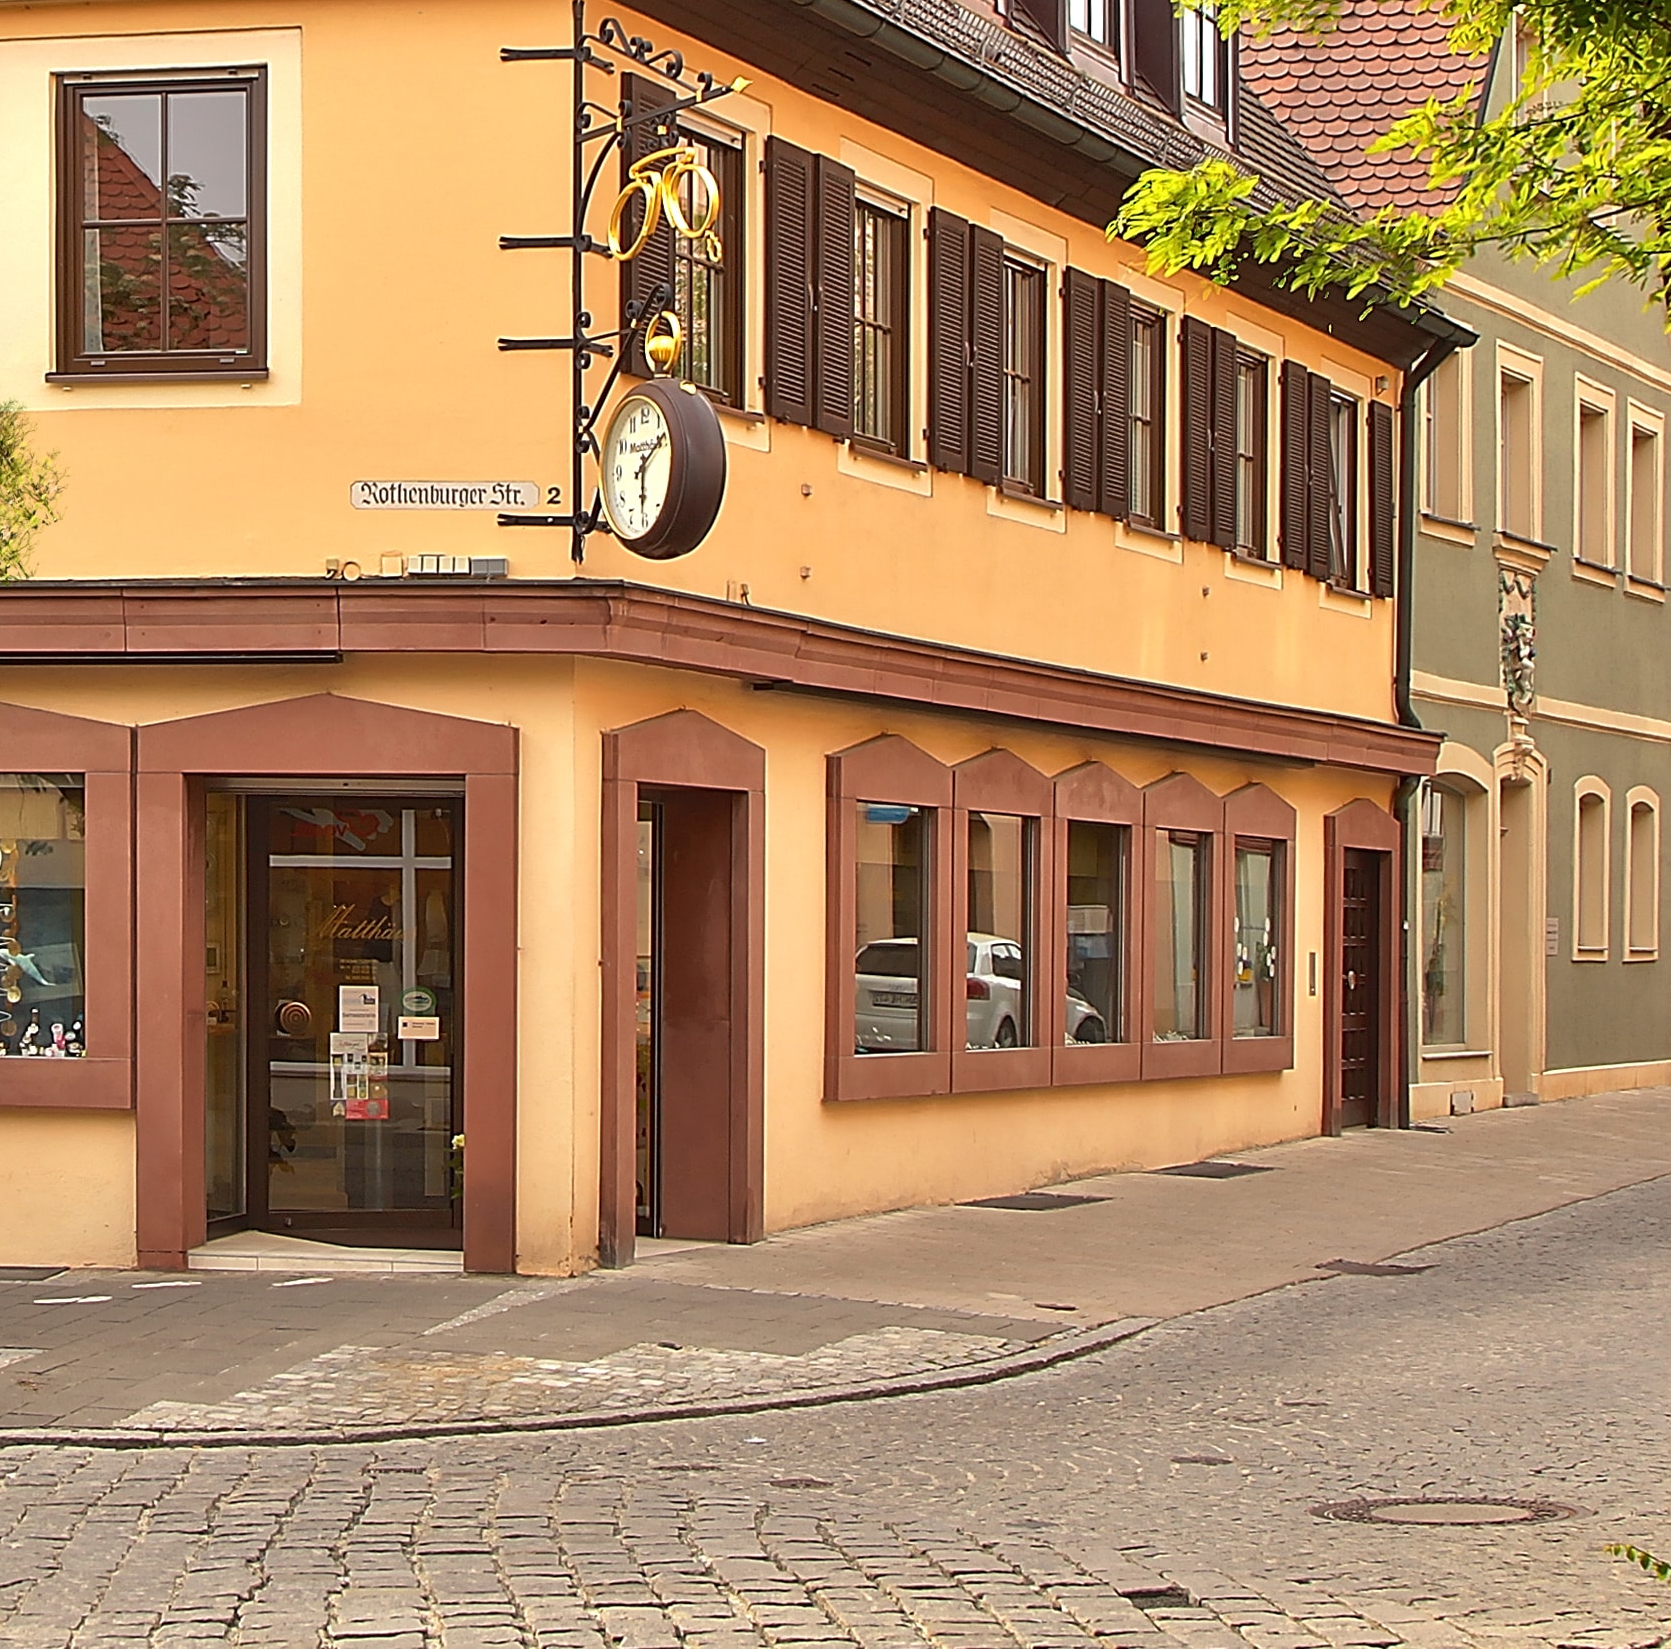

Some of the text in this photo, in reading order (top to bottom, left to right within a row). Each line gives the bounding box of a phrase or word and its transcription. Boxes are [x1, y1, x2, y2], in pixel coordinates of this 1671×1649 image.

[630, 416, 636, 433] 11
[640, 407, 650, 425] 12
[619, 439, 627, 455] 10
[630, 438, 662, 454] Matthä
[616, 465, 622, 481] 9
[360, 482, 526, 508] Rothenburger Str.
[546, 486, 562, 505] 2
[619, 491, 626, 507] 8
[628, 508, 634, 525] 7
[641, 512, 649, 528] 6
[316, 903, 416, 941] Matthäu
